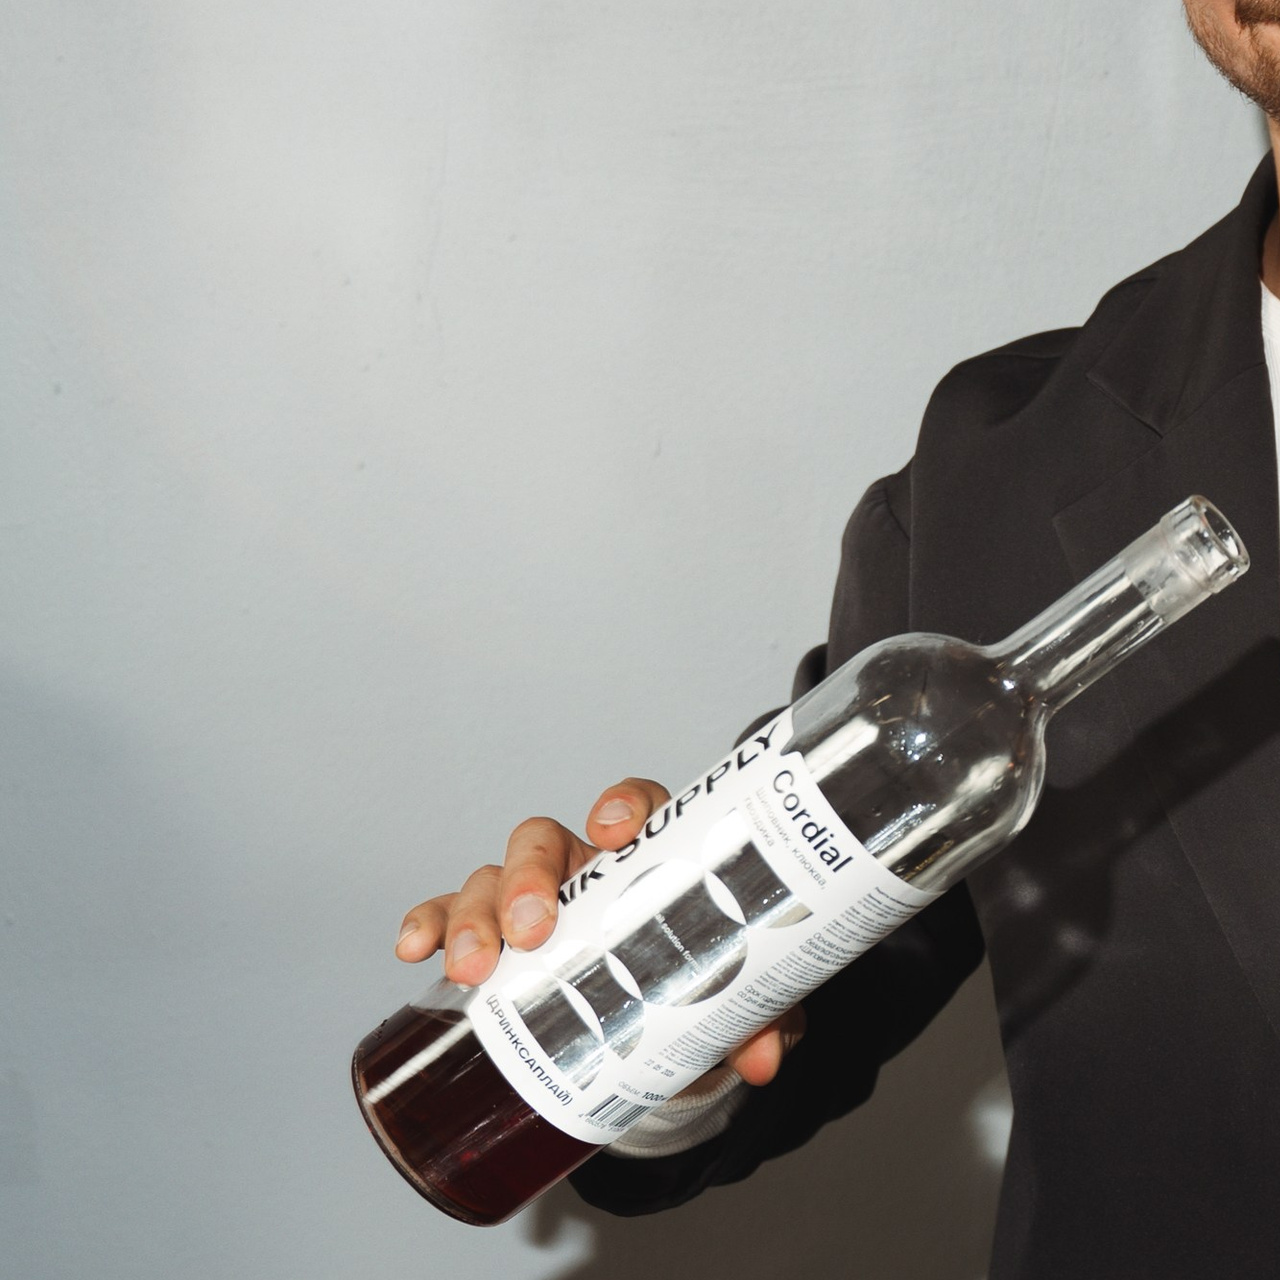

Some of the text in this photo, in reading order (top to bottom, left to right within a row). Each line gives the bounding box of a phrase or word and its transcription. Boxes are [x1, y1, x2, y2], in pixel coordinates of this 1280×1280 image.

[615, 722, 781, 863] SUPPLY
[744, 796, 776, 848] гвоздика
[755, 786, 829, 891] Шиповник, клюква,
[772, 769, 854, 874] Cordial
[661, 922, 685, 953] solution
[485, 993, 574, 1107] (ДРИНКСАПЛАЙ)
